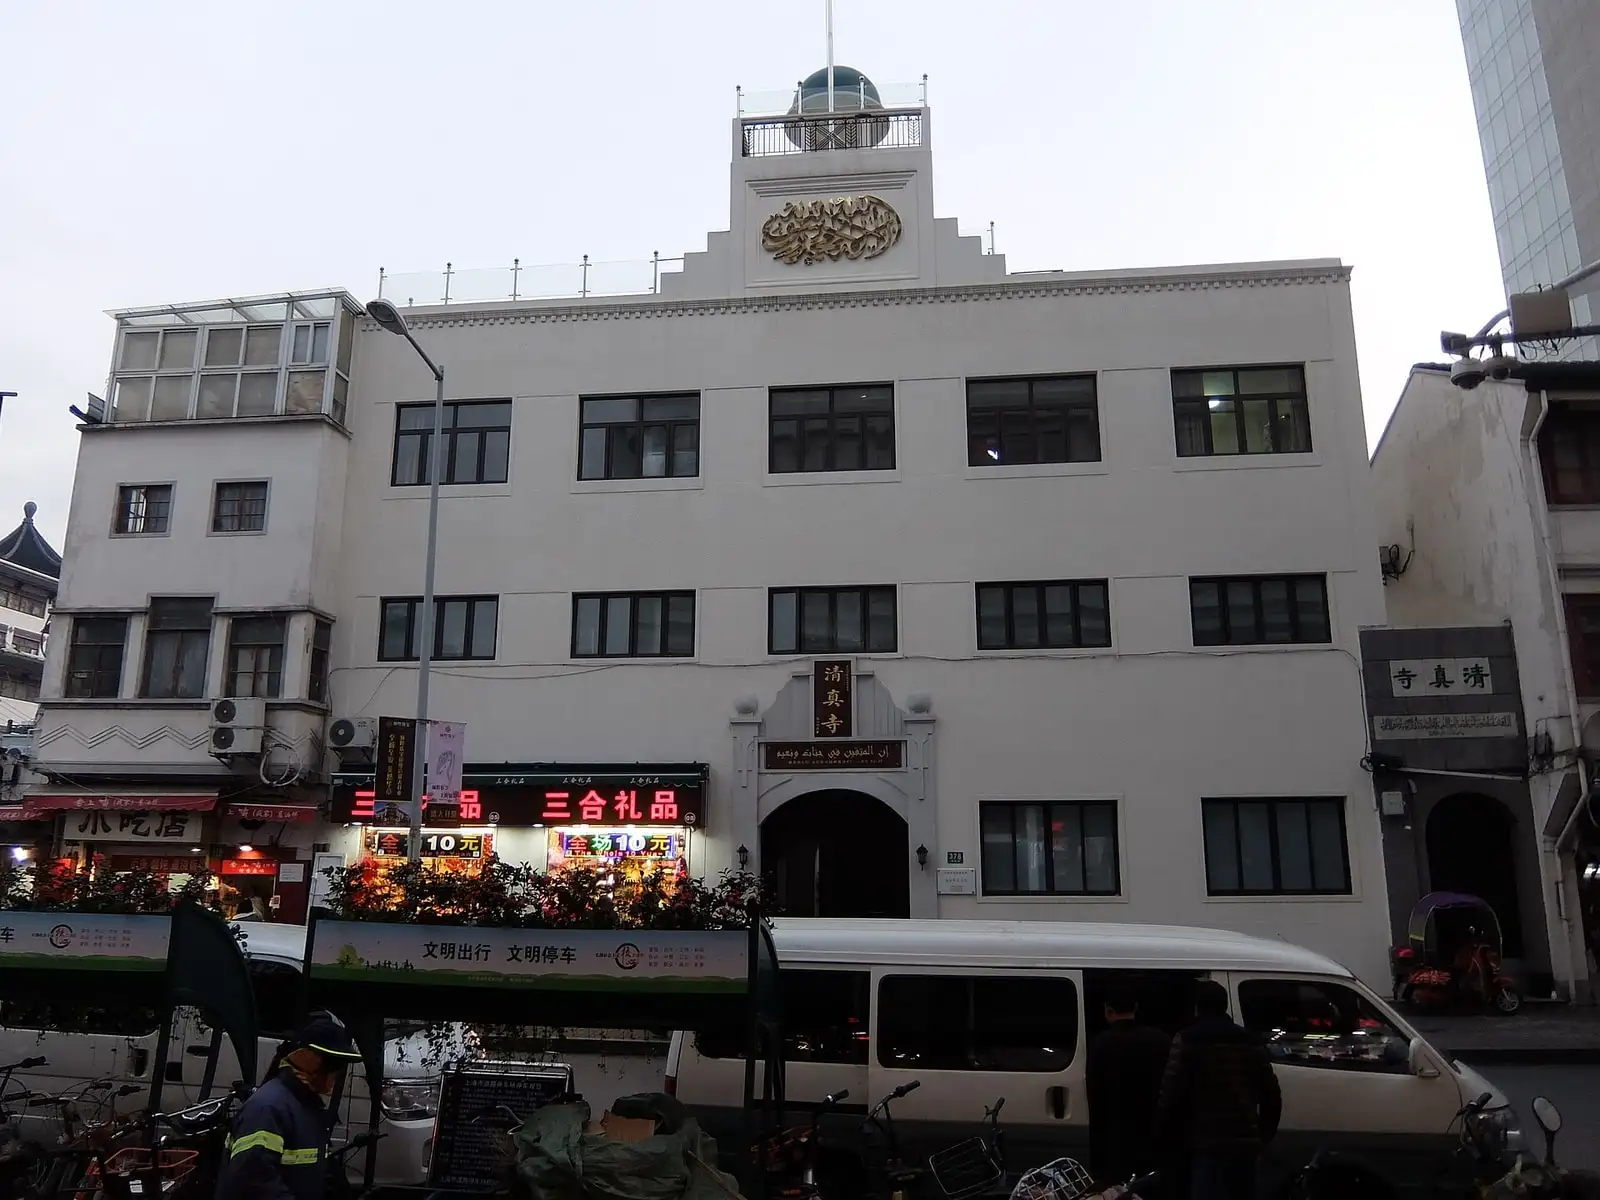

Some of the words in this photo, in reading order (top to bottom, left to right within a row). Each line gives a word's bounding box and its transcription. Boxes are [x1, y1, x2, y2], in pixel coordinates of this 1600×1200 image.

[820, 665, 844, 734] 清真寺
[542, 789, 678, 820] 三合礼品
[78, 810, 189, 837] 小吃店
[422, 941, 491, 962] 文明出行
[506, 944, 577, 964] 文明停车
